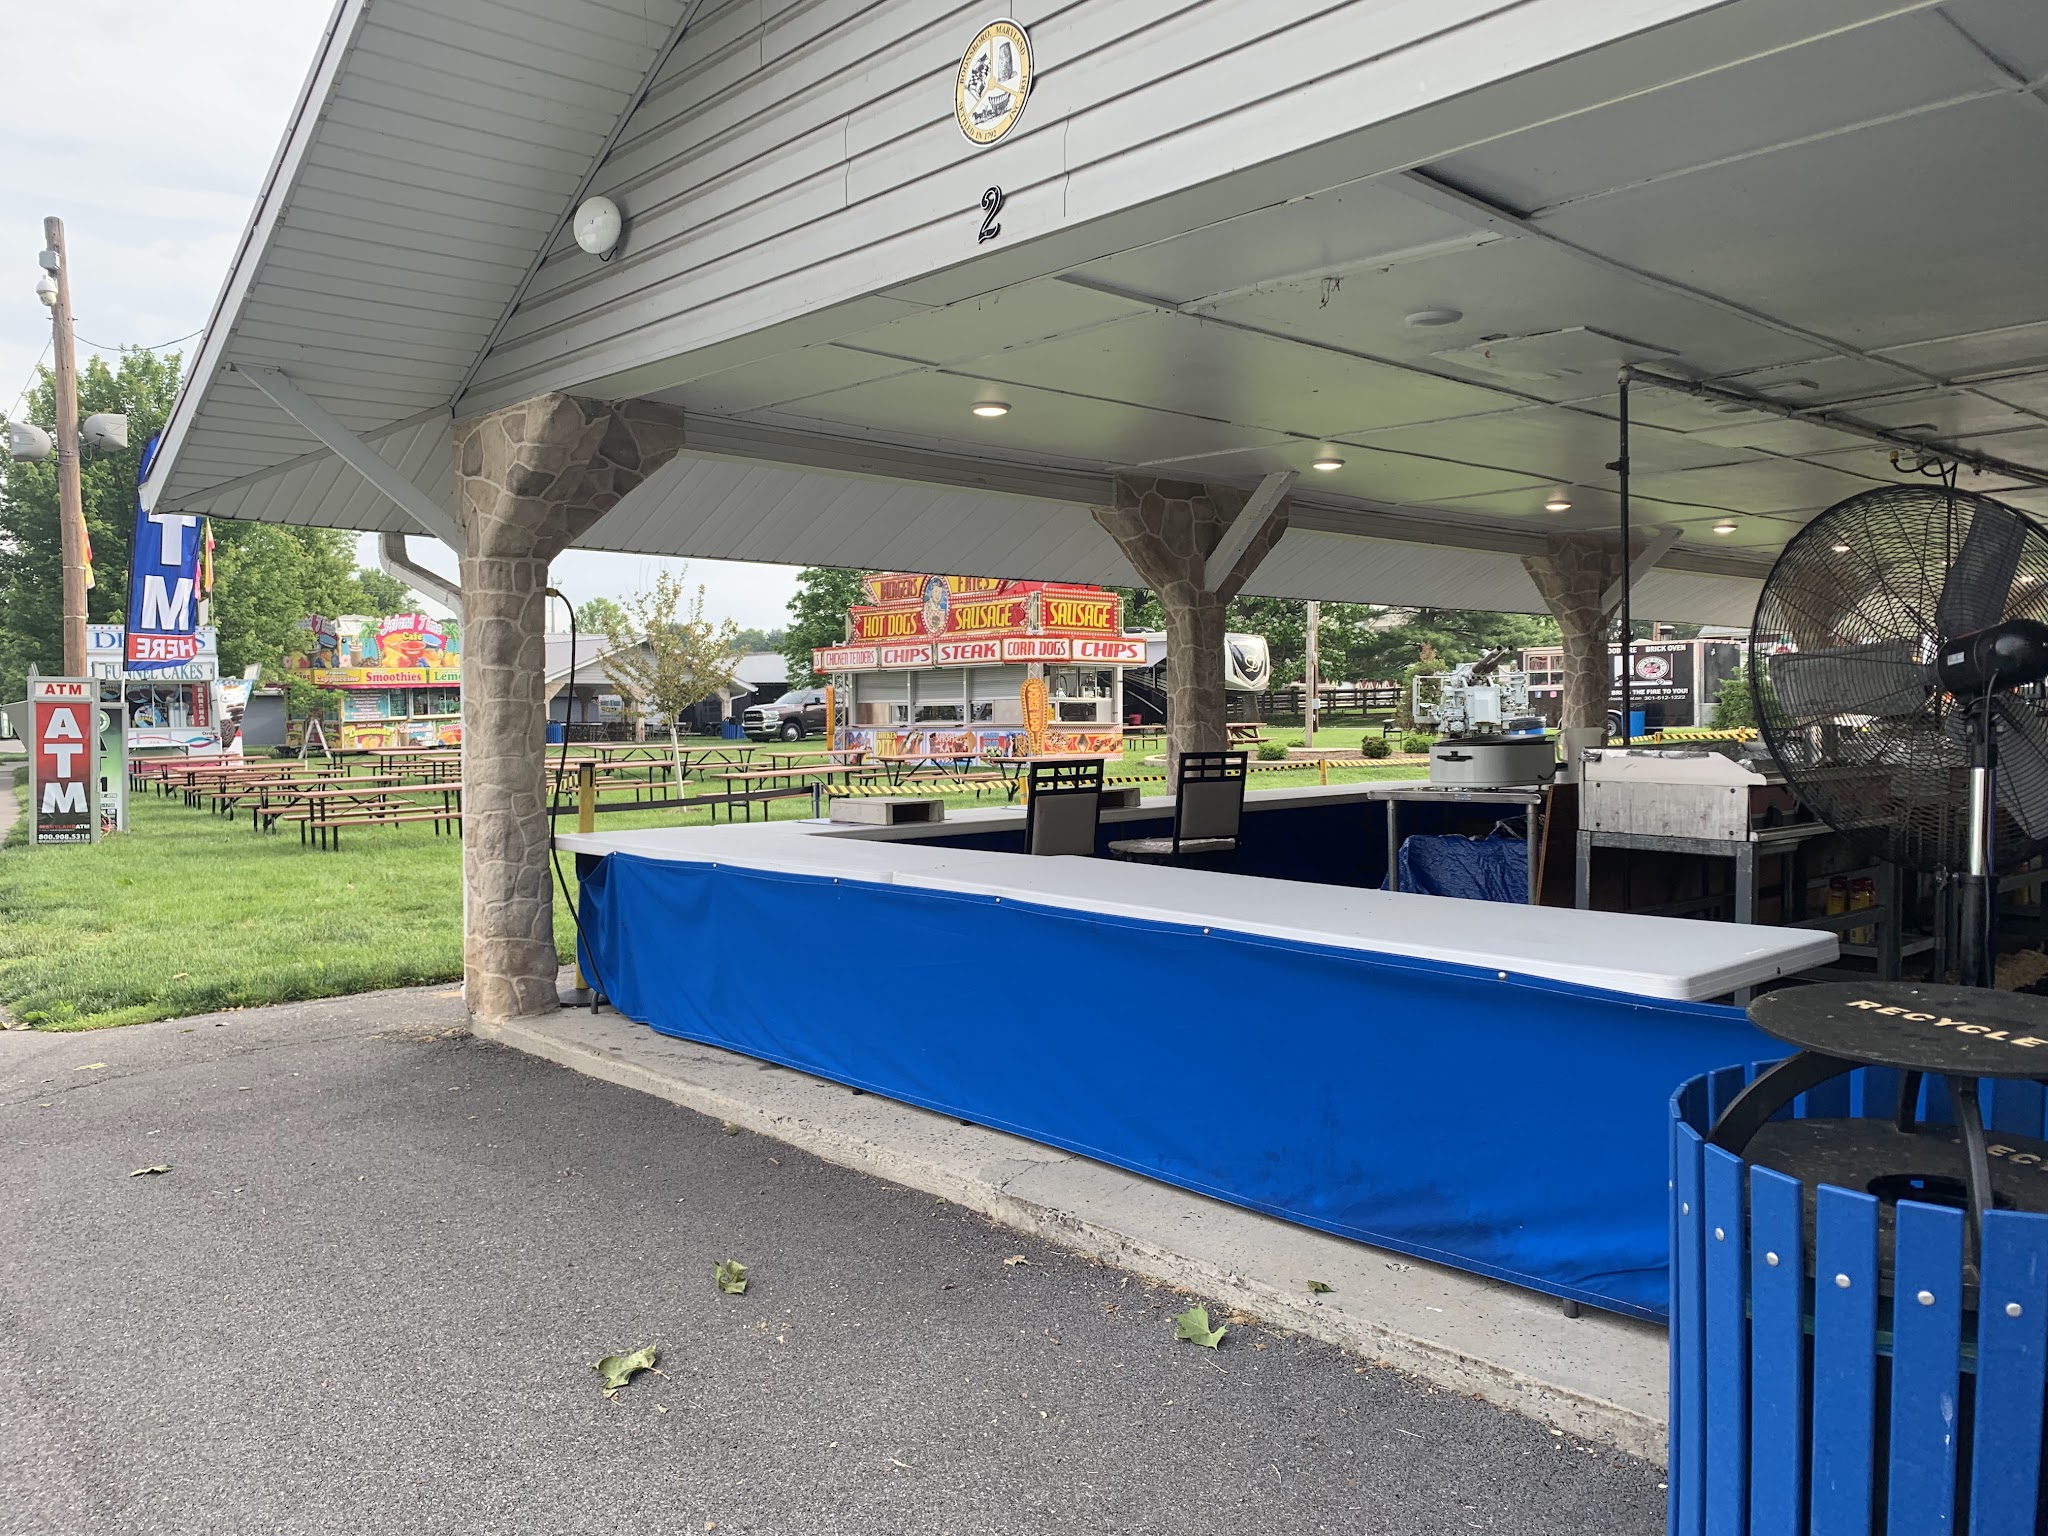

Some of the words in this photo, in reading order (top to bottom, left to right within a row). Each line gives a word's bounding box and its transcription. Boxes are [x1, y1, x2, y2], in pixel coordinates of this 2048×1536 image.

[995, 25, 1026, 56] MARYLAND
[958, 101, 976, 136] SETTLED
[984, 130, 997, 140] 1792
[978, 185, 1001, 243] 2
[141, 513, 197, 631] TM
[880, 580, 917, 600] BURGERS
[955, 603, 1012, 630] SAUSAGE
[1049, 602, 1111, 628] SAUSAGE
[863, 615, 886, 638] HOT
[890, 612, 917, 636] DOGS
[884, 648, 930, 664] CHIPS
[941, 643, 996, 660] STEAK
[1007, 642, 1035, 656] CORN
[1040, 641, 1066, 656] DOGS
[1081, 642, 1137, 658] CHIPS
[1667, 644, 1686, 652] OVEN
[827, 652, 848, 666] CHICKEN
[849, 650, 875, 664] TENDERS
[161, 664, 204, 680] CAKES
[366, 671, 421, 682] Smoothies
[434, 671, 460, 681] Lem
[44, 683, 82, 695] ATM
[876, 740, 897, 756] PITA
[41, 707, 89, 813] ATM
[1846, 999, 2048, 1048] RECYCLE
